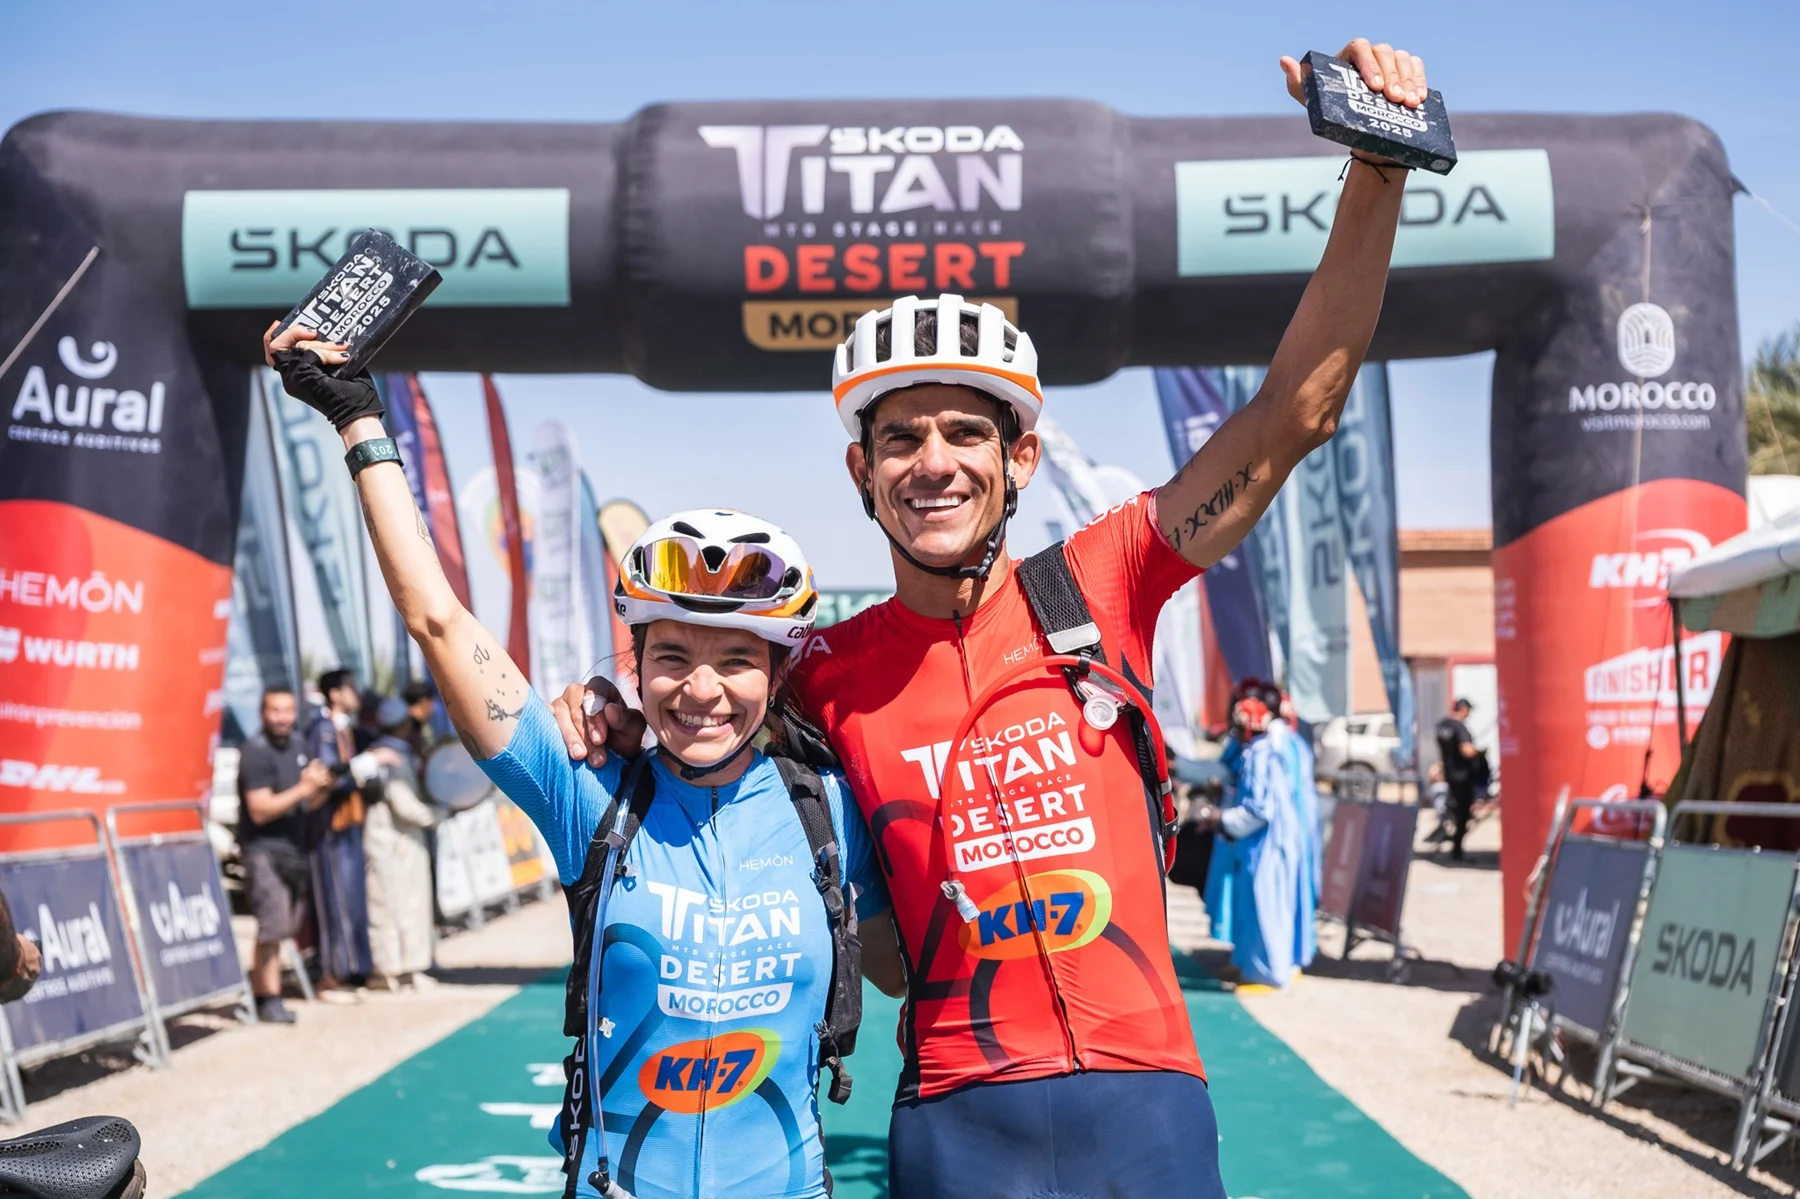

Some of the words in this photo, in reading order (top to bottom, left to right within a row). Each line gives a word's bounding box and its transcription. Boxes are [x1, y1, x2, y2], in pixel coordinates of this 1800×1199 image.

[1356, 103, 1421, 128] MOROCCO
[1369, 118, 1413, 138] 2025
[699, 125, 1024, 221] TITAN
[831, 220, 918, 237] STAGE
[932, 220, 1003, 236] RACE
[1224, 185, 1507, 235] SKDA
[230, 227, 521, 270] SKDA
[743, 242, 1026, 292] DESERT
[318, 253, 365, 300] SKODA
[318, 264, 383, 336] DESERT
[335, 279, 388, 337] MOROCCO
[353, 296, 392, 337] 2025
[12, 365, 166, 433] Aural
[1568, 381, 1717, 413] MOROCCO
[900, 731, 1077, 800] TITAN
[1036, 773, 1072, 788] RACE
[961, 827, 1084, 866] MOROCCO
[647, 880, 801, 948] TITAN
[709, 889, 800, 914] SKODA
[38, 901, 112, 974] Aural
[672, 945, 698, 956] MTB
[757, 941, 793, 953] RACE
[1652, 921, 1757, 996] SKODA
[660, 952, 802, 988] DESERT
[669, 989, 781, 1015] MOROCCO
